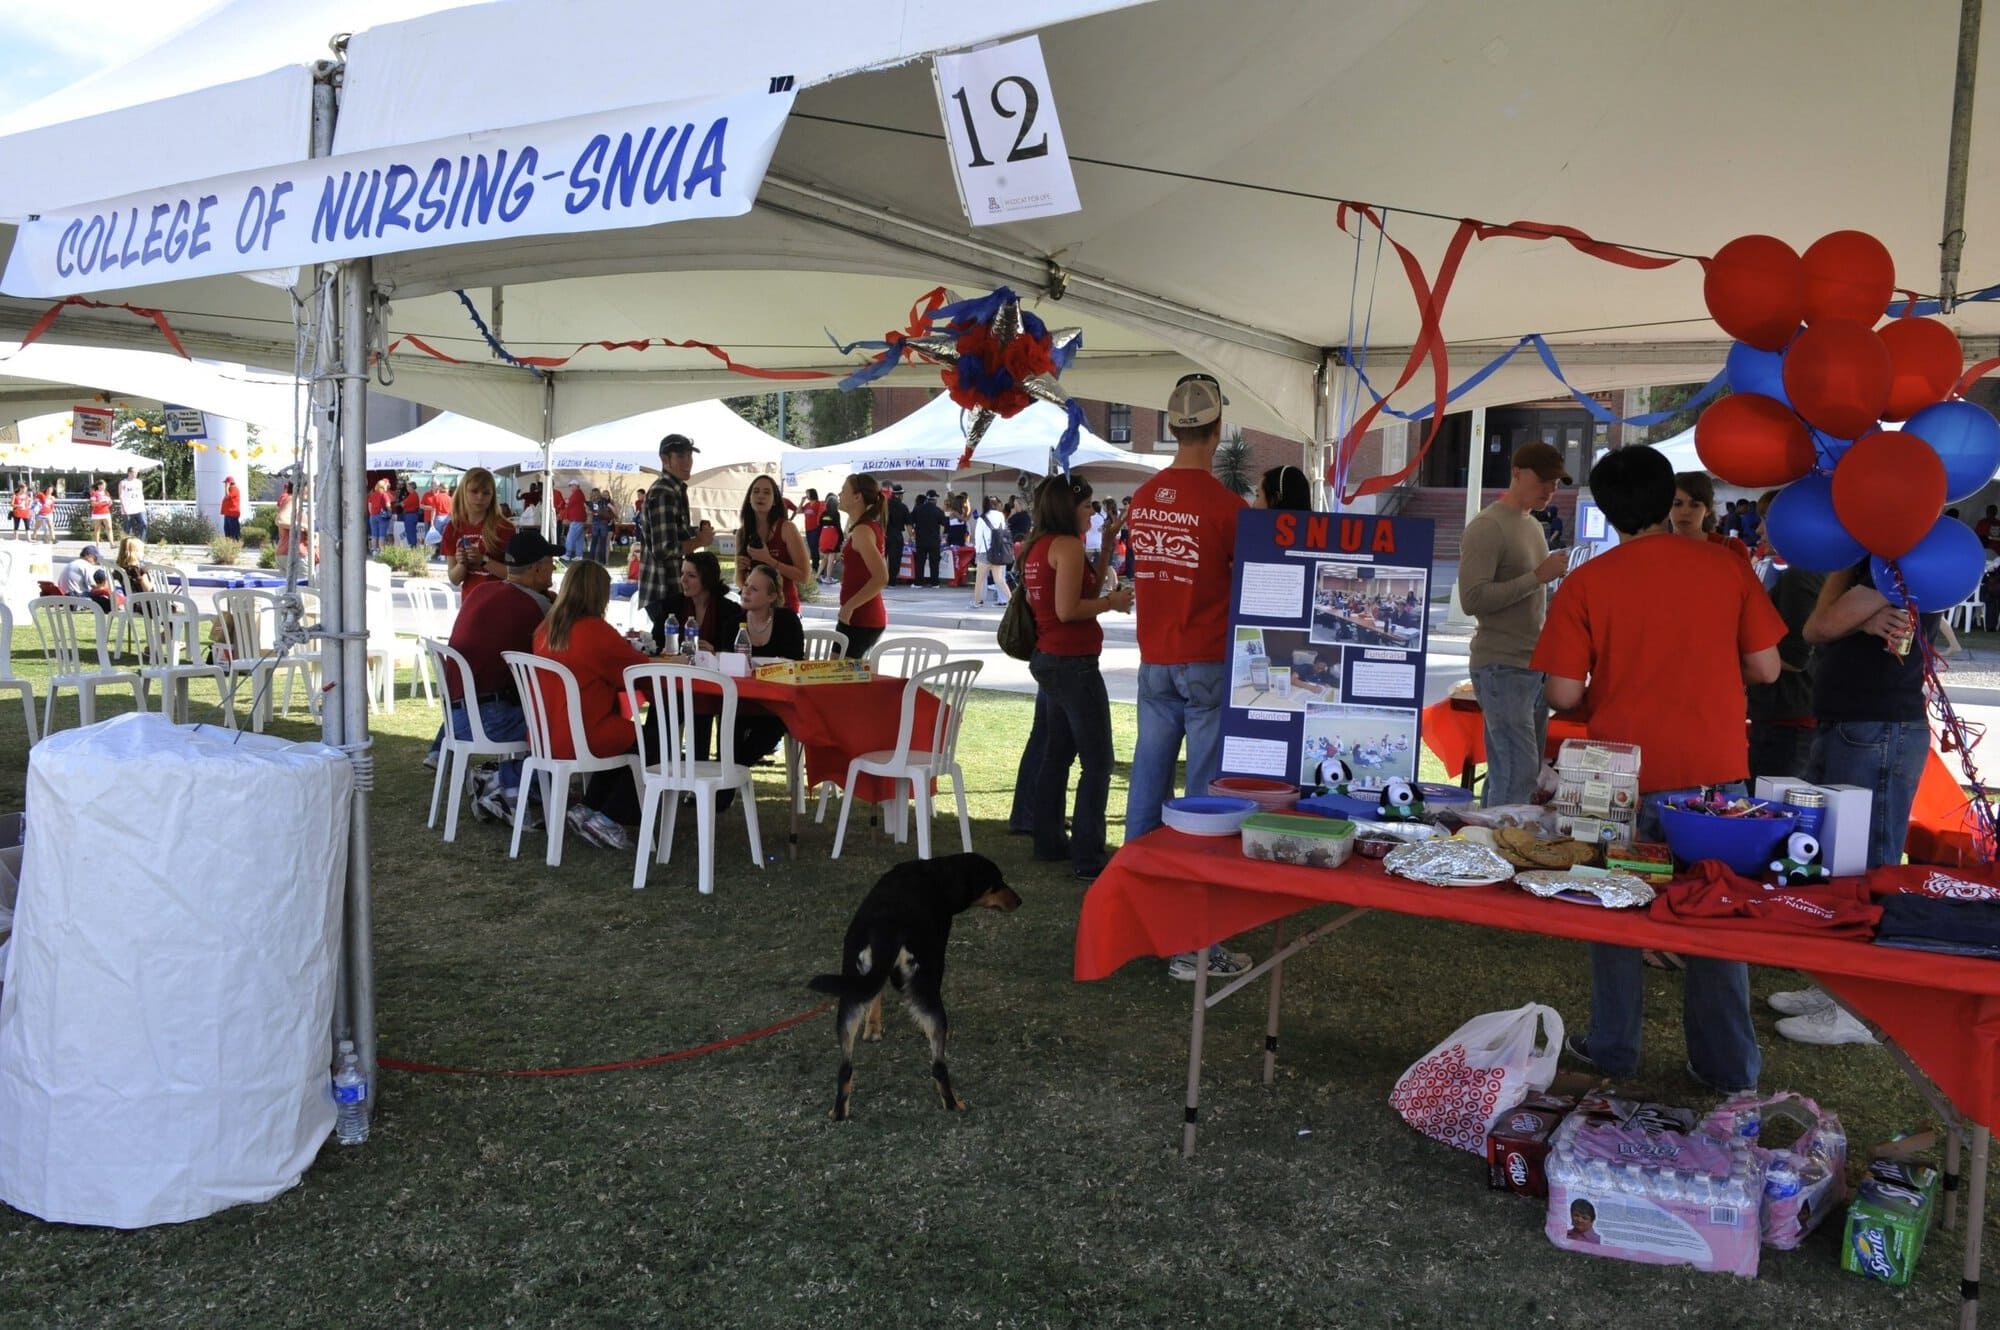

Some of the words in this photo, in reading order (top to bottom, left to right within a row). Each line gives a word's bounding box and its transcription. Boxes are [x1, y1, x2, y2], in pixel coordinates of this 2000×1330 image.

[951, 75, 1049, 168] 12
[56, 194, 218, 279] COLLEGE
[235, 181, 294, 254] OF
[311, 116, 729, 244] NURSING-SNUA
[615, 462, 634, 472] BAND
[862, 459, 901, 470] ARIZONA
[905, 458, 925, 468] POM
[930, 458, 951, 468] LINE
[1274, 512, 1397, 553] SNUA
[1249, 711, 1290, 721] Volunteer
[1785, 899, 1834, 919] Nursing
[1868, 1229, 1890, 1278] Sprite
